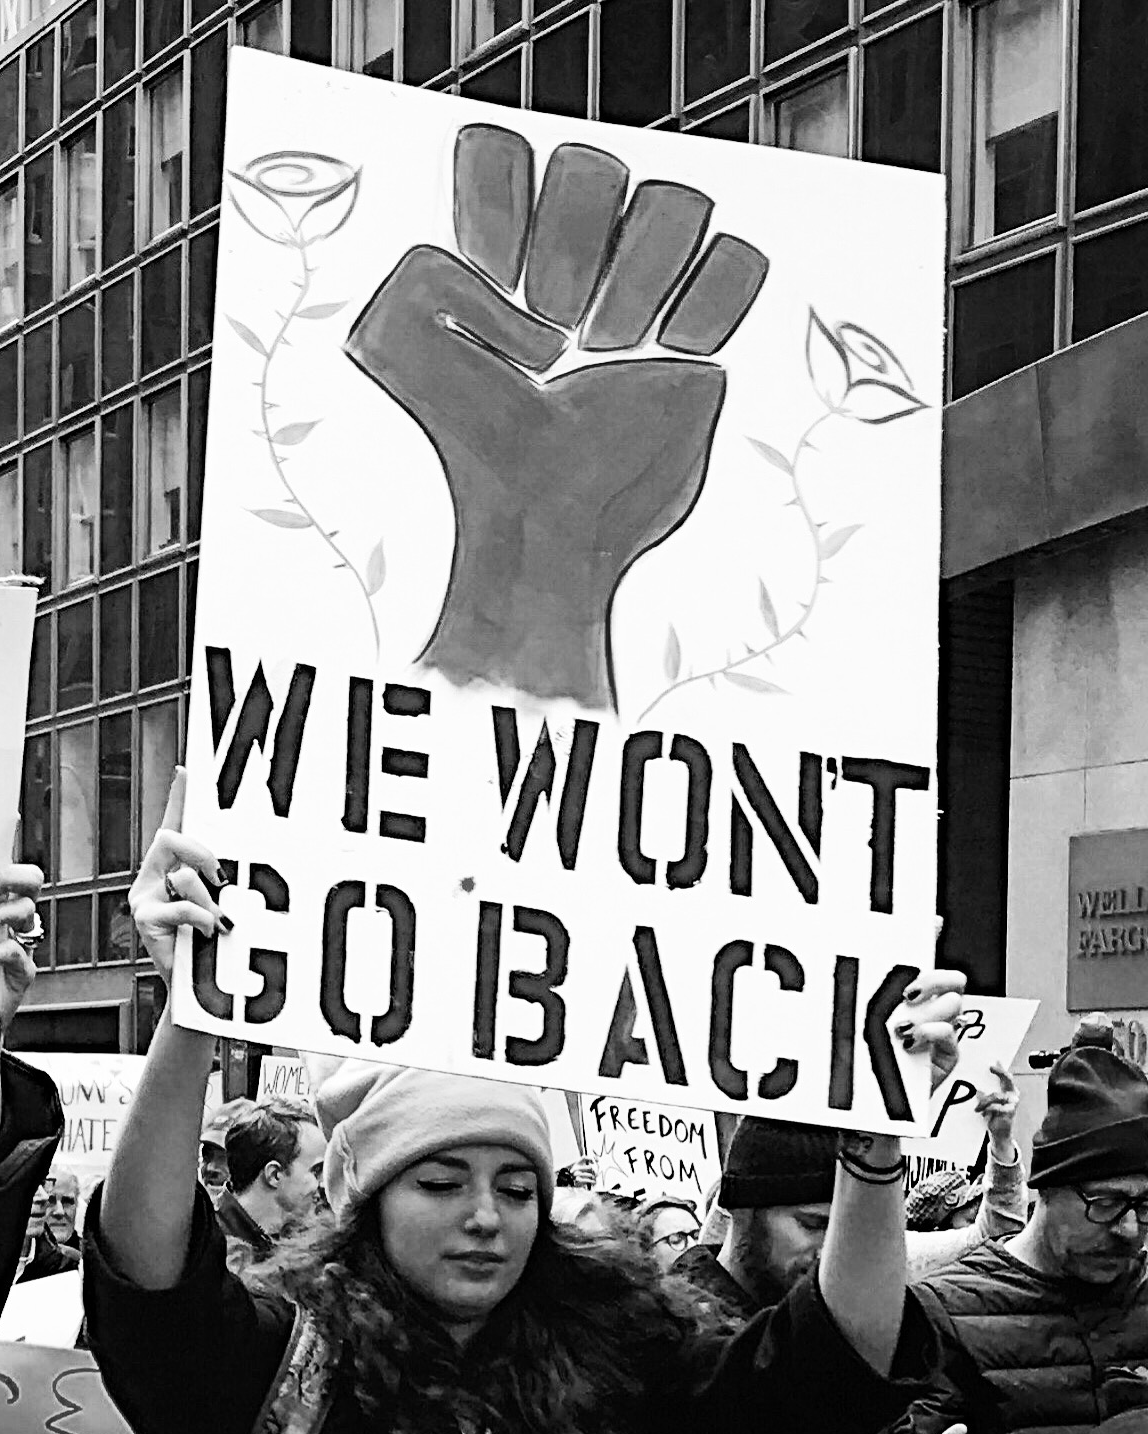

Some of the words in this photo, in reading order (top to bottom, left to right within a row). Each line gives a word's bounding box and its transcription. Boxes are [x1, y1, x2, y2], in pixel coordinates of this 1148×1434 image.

[205, 646, 431, 843] WE
[491, 705, 931, 915] WON'T
[191, 858, 417, 1046] GO
[472, 900, 922, 1123] BACK
[263, 1065, 311, 1096] WOME
[60, 1118, 117, 1153] HATE
[590, 1096, 707, 1159] FREEDOM
[624, 1146, 702, 1194] FROM
